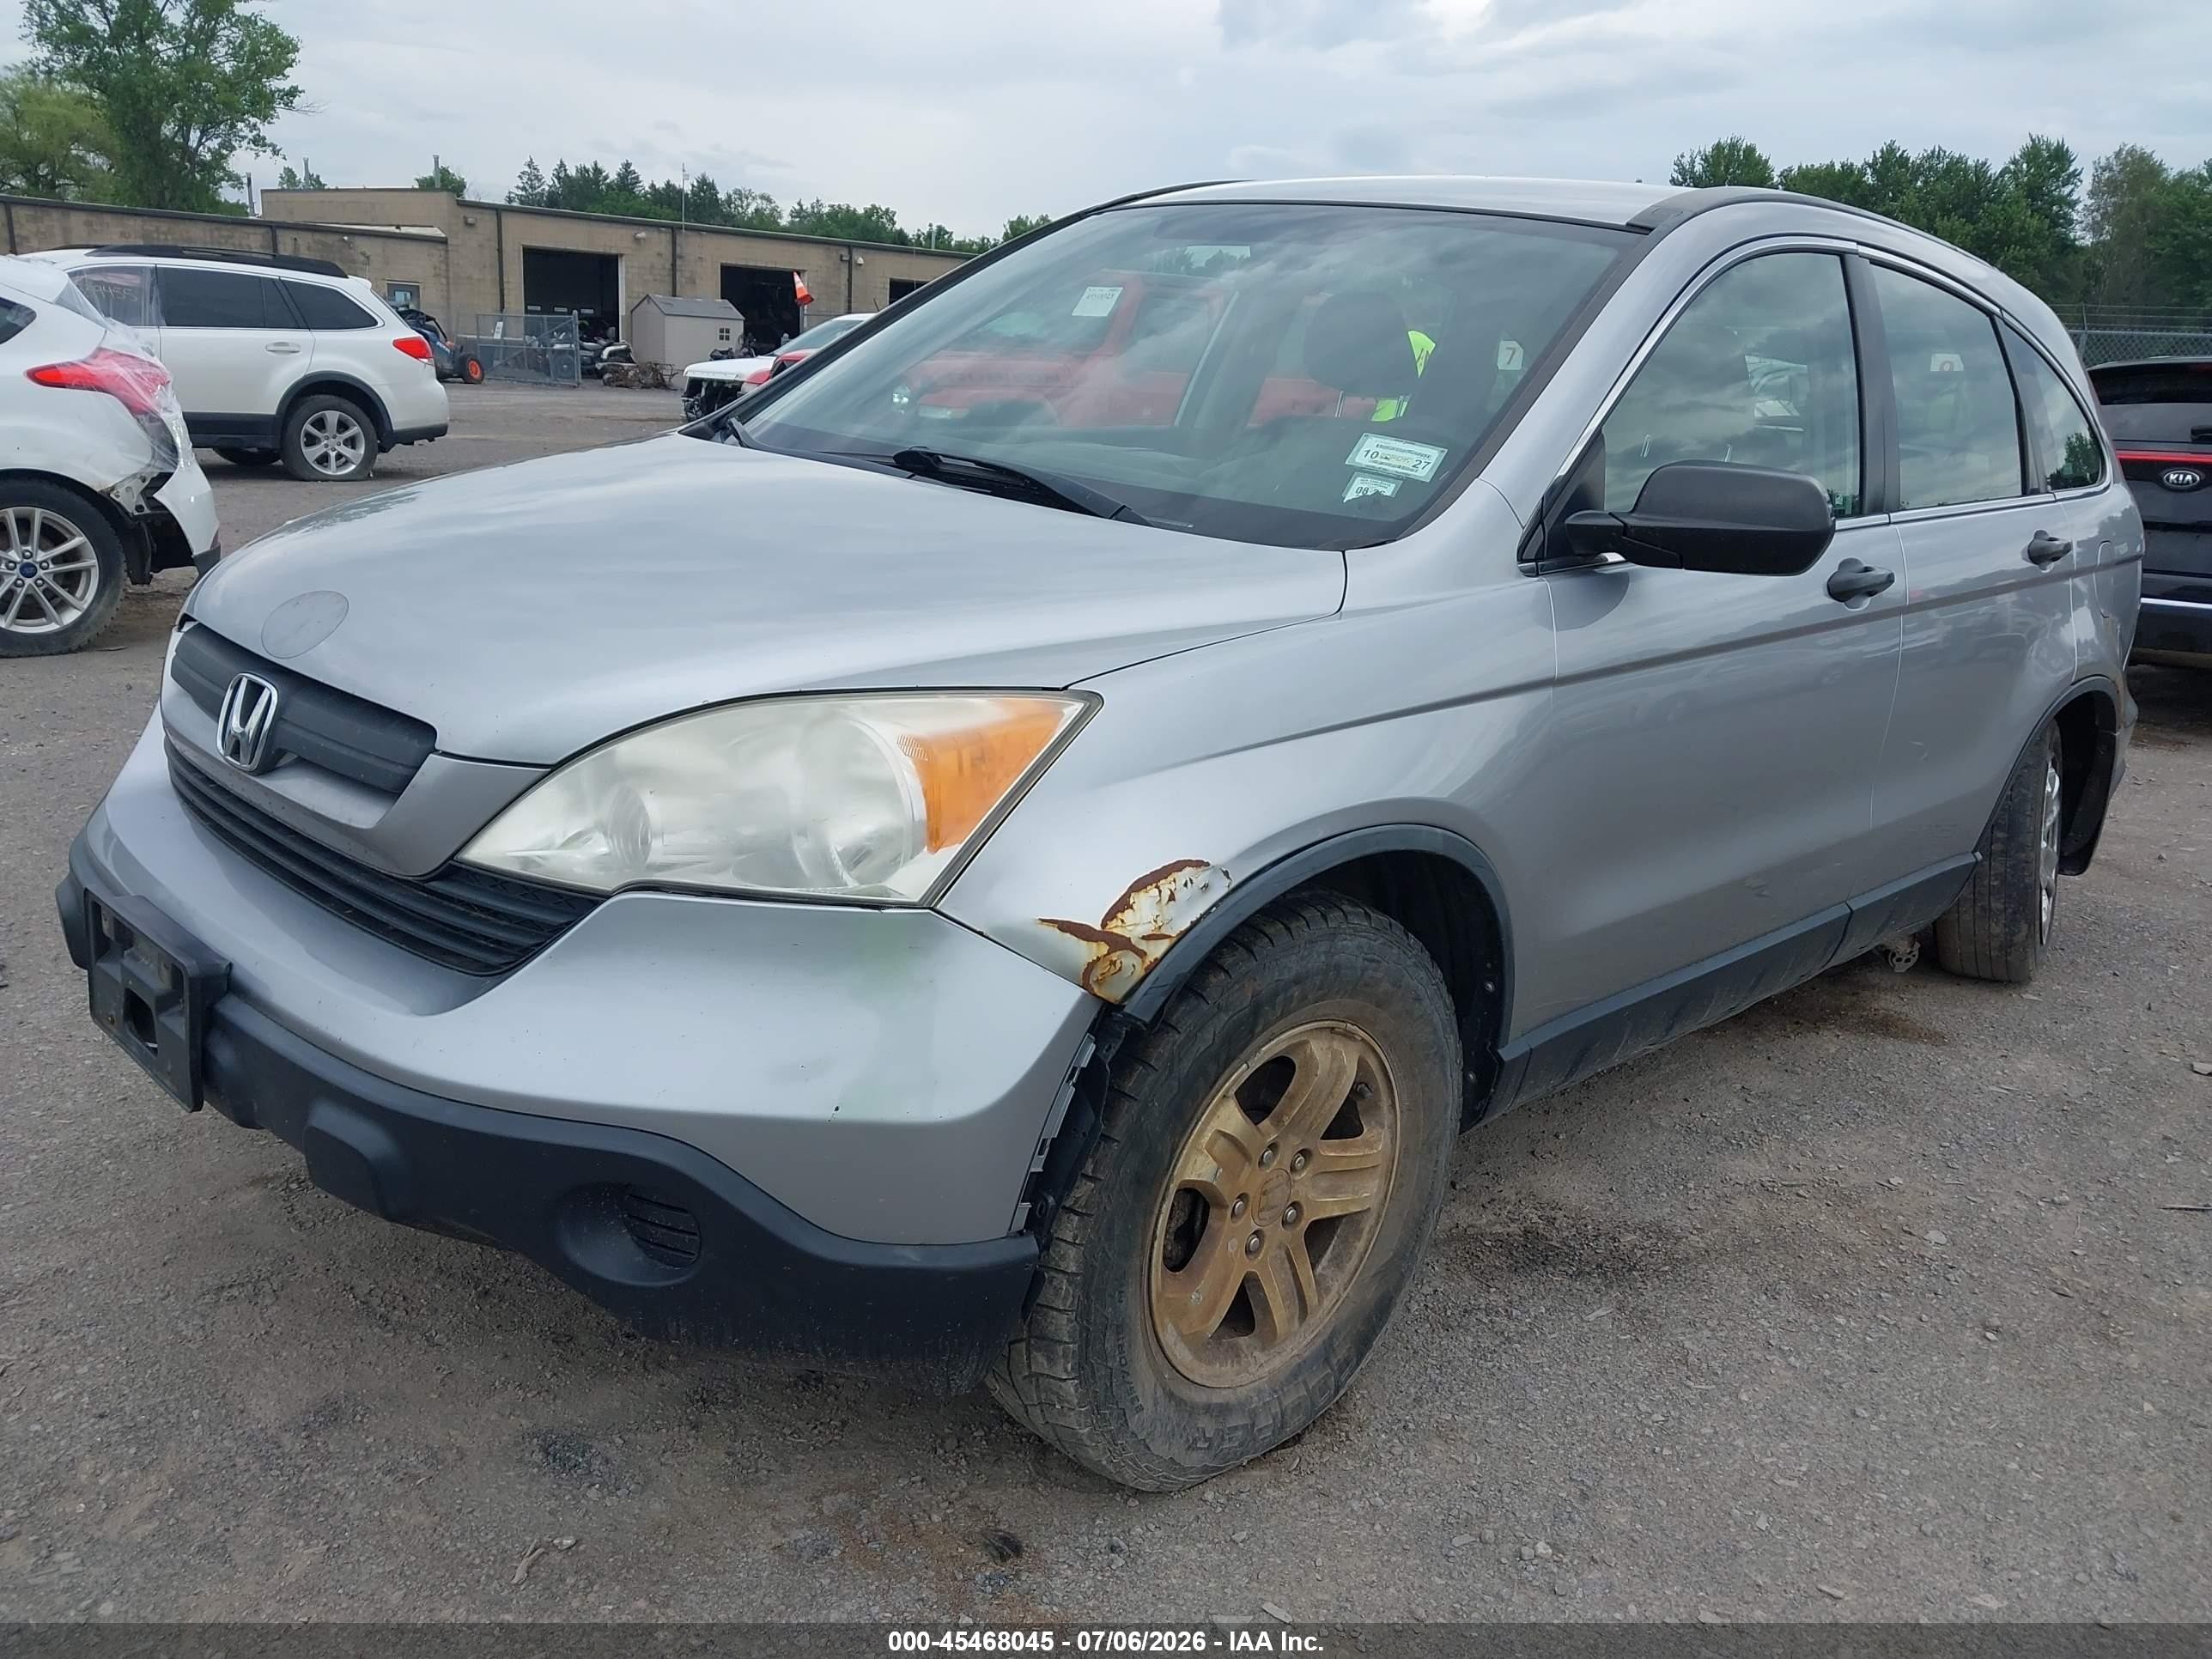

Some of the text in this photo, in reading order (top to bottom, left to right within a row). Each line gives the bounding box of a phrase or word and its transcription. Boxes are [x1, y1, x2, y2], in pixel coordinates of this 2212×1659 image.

[1505, 346, 1518, 365] 7
[1364, 448, 1380, 459] 10
[1411, 459, 1431, 471] 27
[2168, 472, 2193, 484] KIA
